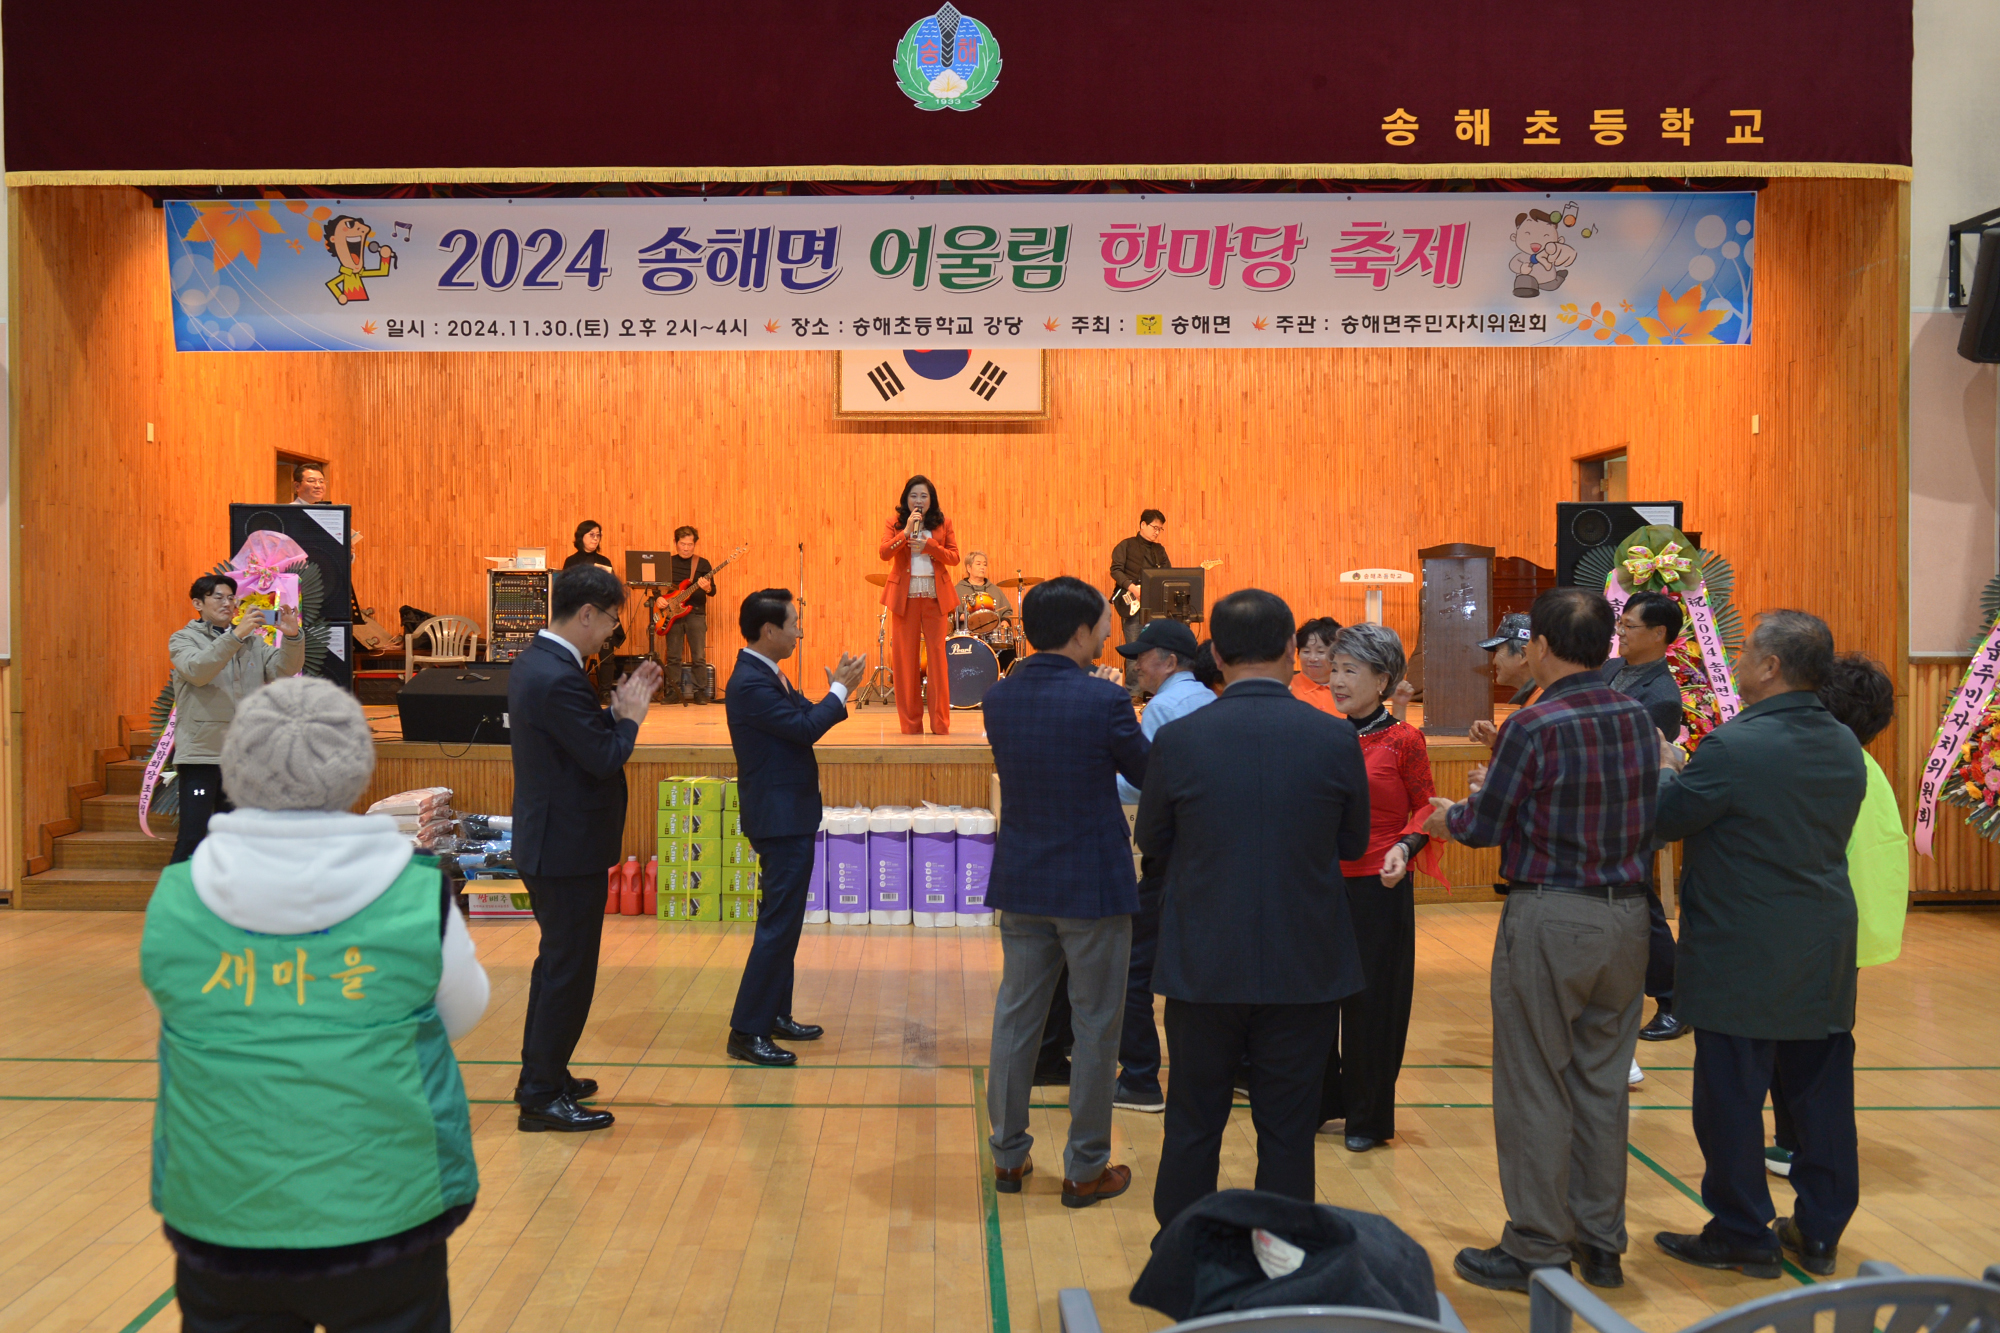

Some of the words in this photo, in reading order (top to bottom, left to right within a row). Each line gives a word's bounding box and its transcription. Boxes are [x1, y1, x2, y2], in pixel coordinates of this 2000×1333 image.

[437, 227, 612, 292] 2024
[637, 224, 843, 295] 송해면
[869, 223, 1073, 293] 어울림
[1098, 221, 1308, 292] 한마당
[1330, 220, 1470, 292] 축제
[386, 318, 425, 338] 일시
[447, 318, 609, 339] 2024.11.30.(토)
[618, 318, 657, 338] 오후
[666, 318, 748, 337] 2시~4시
[791, 317, 830, 337] 장소
[852, 315, 974, 337] 송해초등학교
[983, 316, 1024, 336] 강당
[1071, 315, 1110, 335] 주최
[1170, 314, 1231, 335] 송해면
[1276, 314, 1317, 334] 주관
[1340, 313, 1548, 335] 송해면주민자치위원회
[1363, 572, 1403, 580] 송해초등학교
[1688, 596, 1707, 608] 祝
[1695, 611, 1717, 658] 2024
[948, 642, 974, 656] Pearl
[1707, 662, 1730, 698] 송해면
[1918, 627, 2000, 830] 읍주민자치위원회
[201, 946, 377, 1007] 새마을
